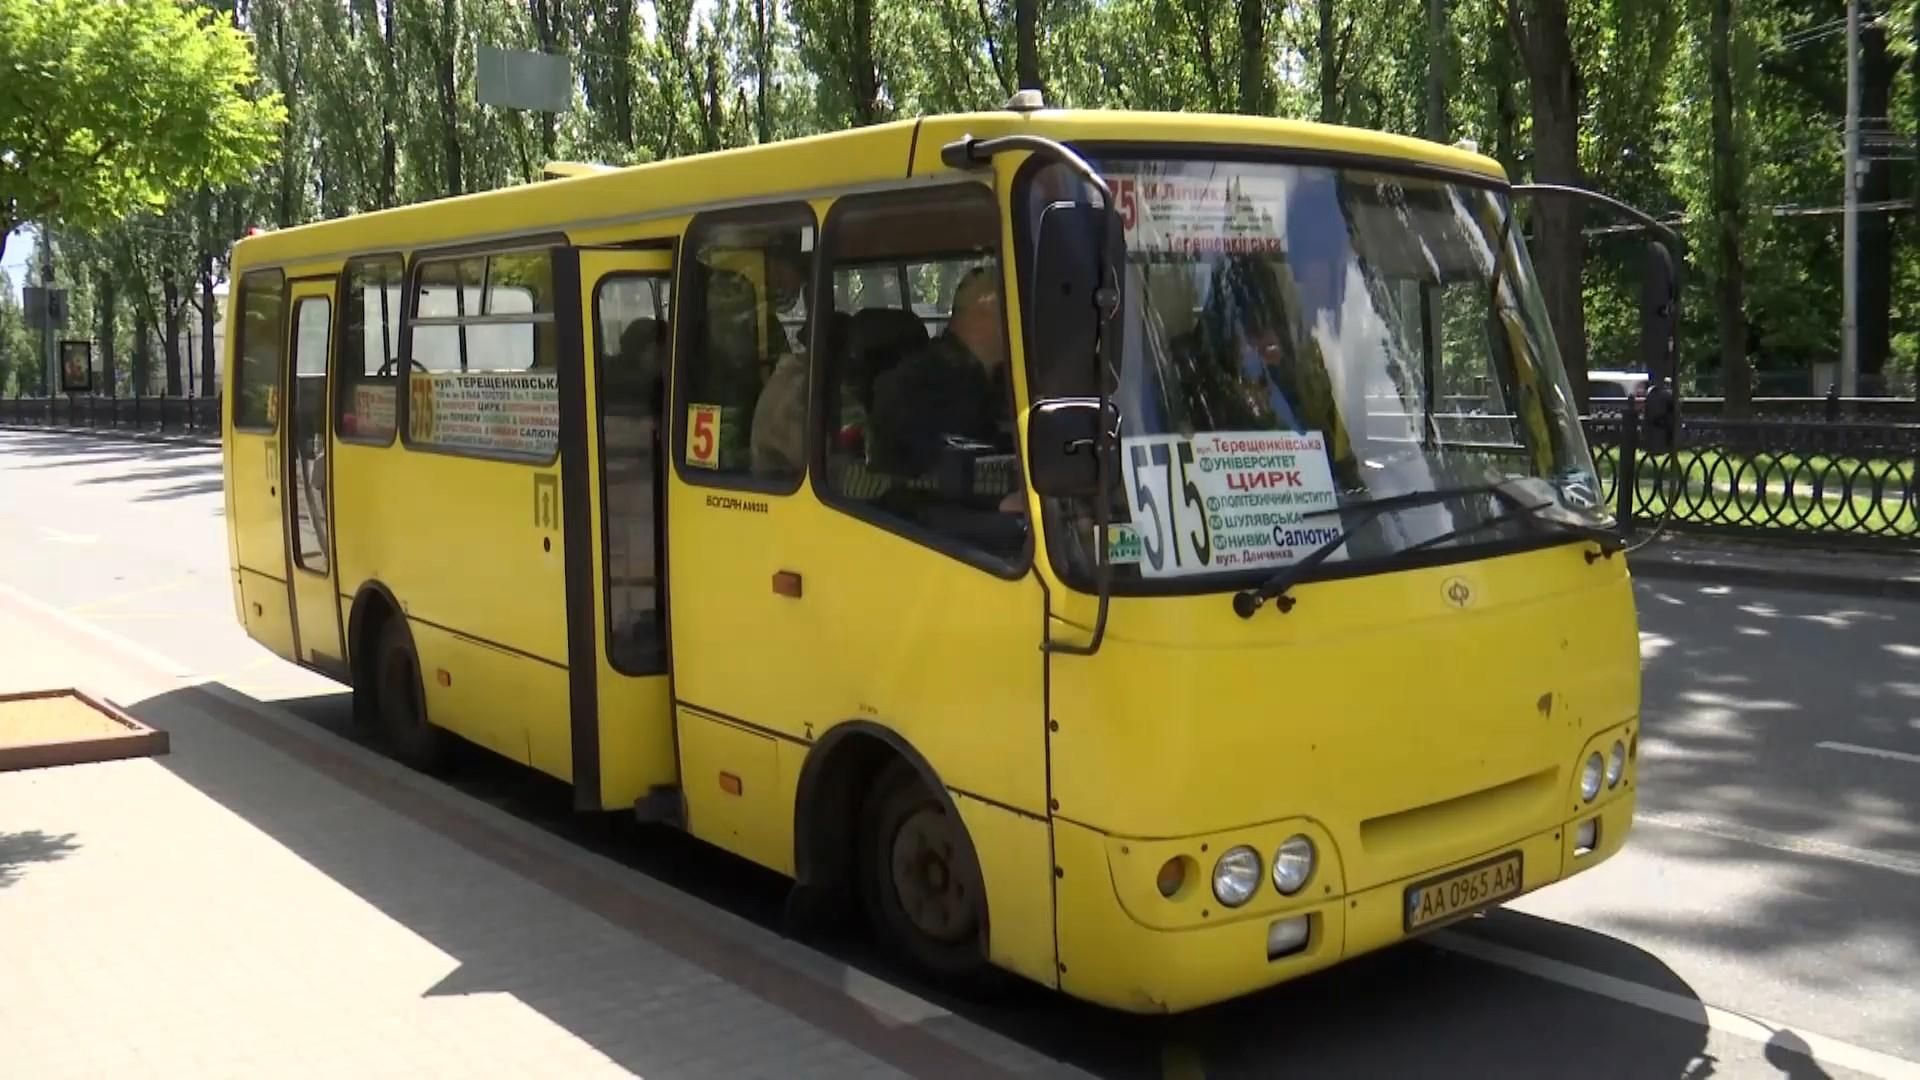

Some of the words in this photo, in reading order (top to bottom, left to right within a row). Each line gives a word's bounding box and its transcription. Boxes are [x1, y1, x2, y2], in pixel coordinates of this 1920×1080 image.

[692, 411, 714, 459] 5
[1211, 437, 1322, 456] Терещенківська
[1213, 454, 1296, 471] УНІВЕРСИТЕТ
[1227, 471, 1303, 493] ЦИРК
[1130, 442, 1211, 572] 575
[1221, 491, 1294, 509] ПОЛІТЕХНІЧНИЙ
[1294, 490, 1333, 504] ІНСТИТУТ
[1224, 511, 1303, 528] ШУЛЯВСЬКА
[1227, 532, 1272, 549] НИВКИ
[1272, 525, 1340, 548] Салютна
[1450, 871, 1489, 908] 0965
